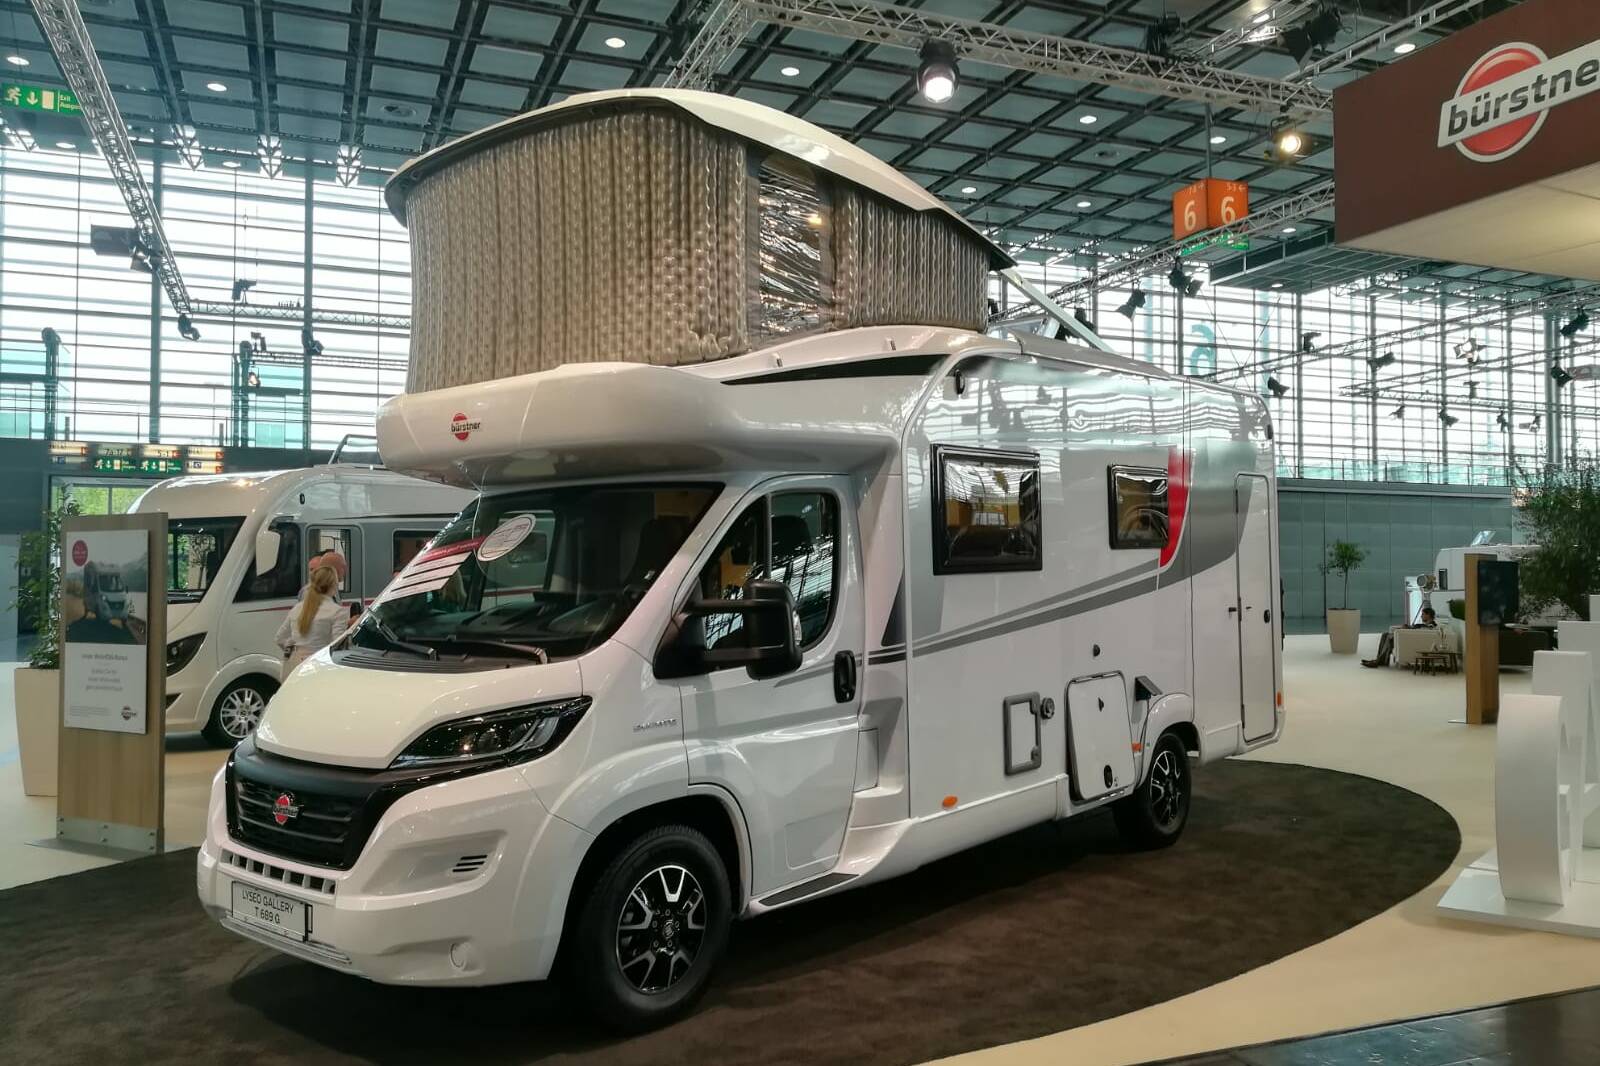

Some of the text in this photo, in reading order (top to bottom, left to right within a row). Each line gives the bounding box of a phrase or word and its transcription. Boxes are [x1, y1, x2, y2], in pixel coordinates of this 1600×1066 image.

[1184, 199, 1197, 231] 6
[1221, 196, 1237, 226] 6
[451, 422, 481, 432] bürstner
[242, 889, 294, 914] LYSEO GALLERY
[254, 906, 259, 917] T
[260, 909, 274, 922] 689
